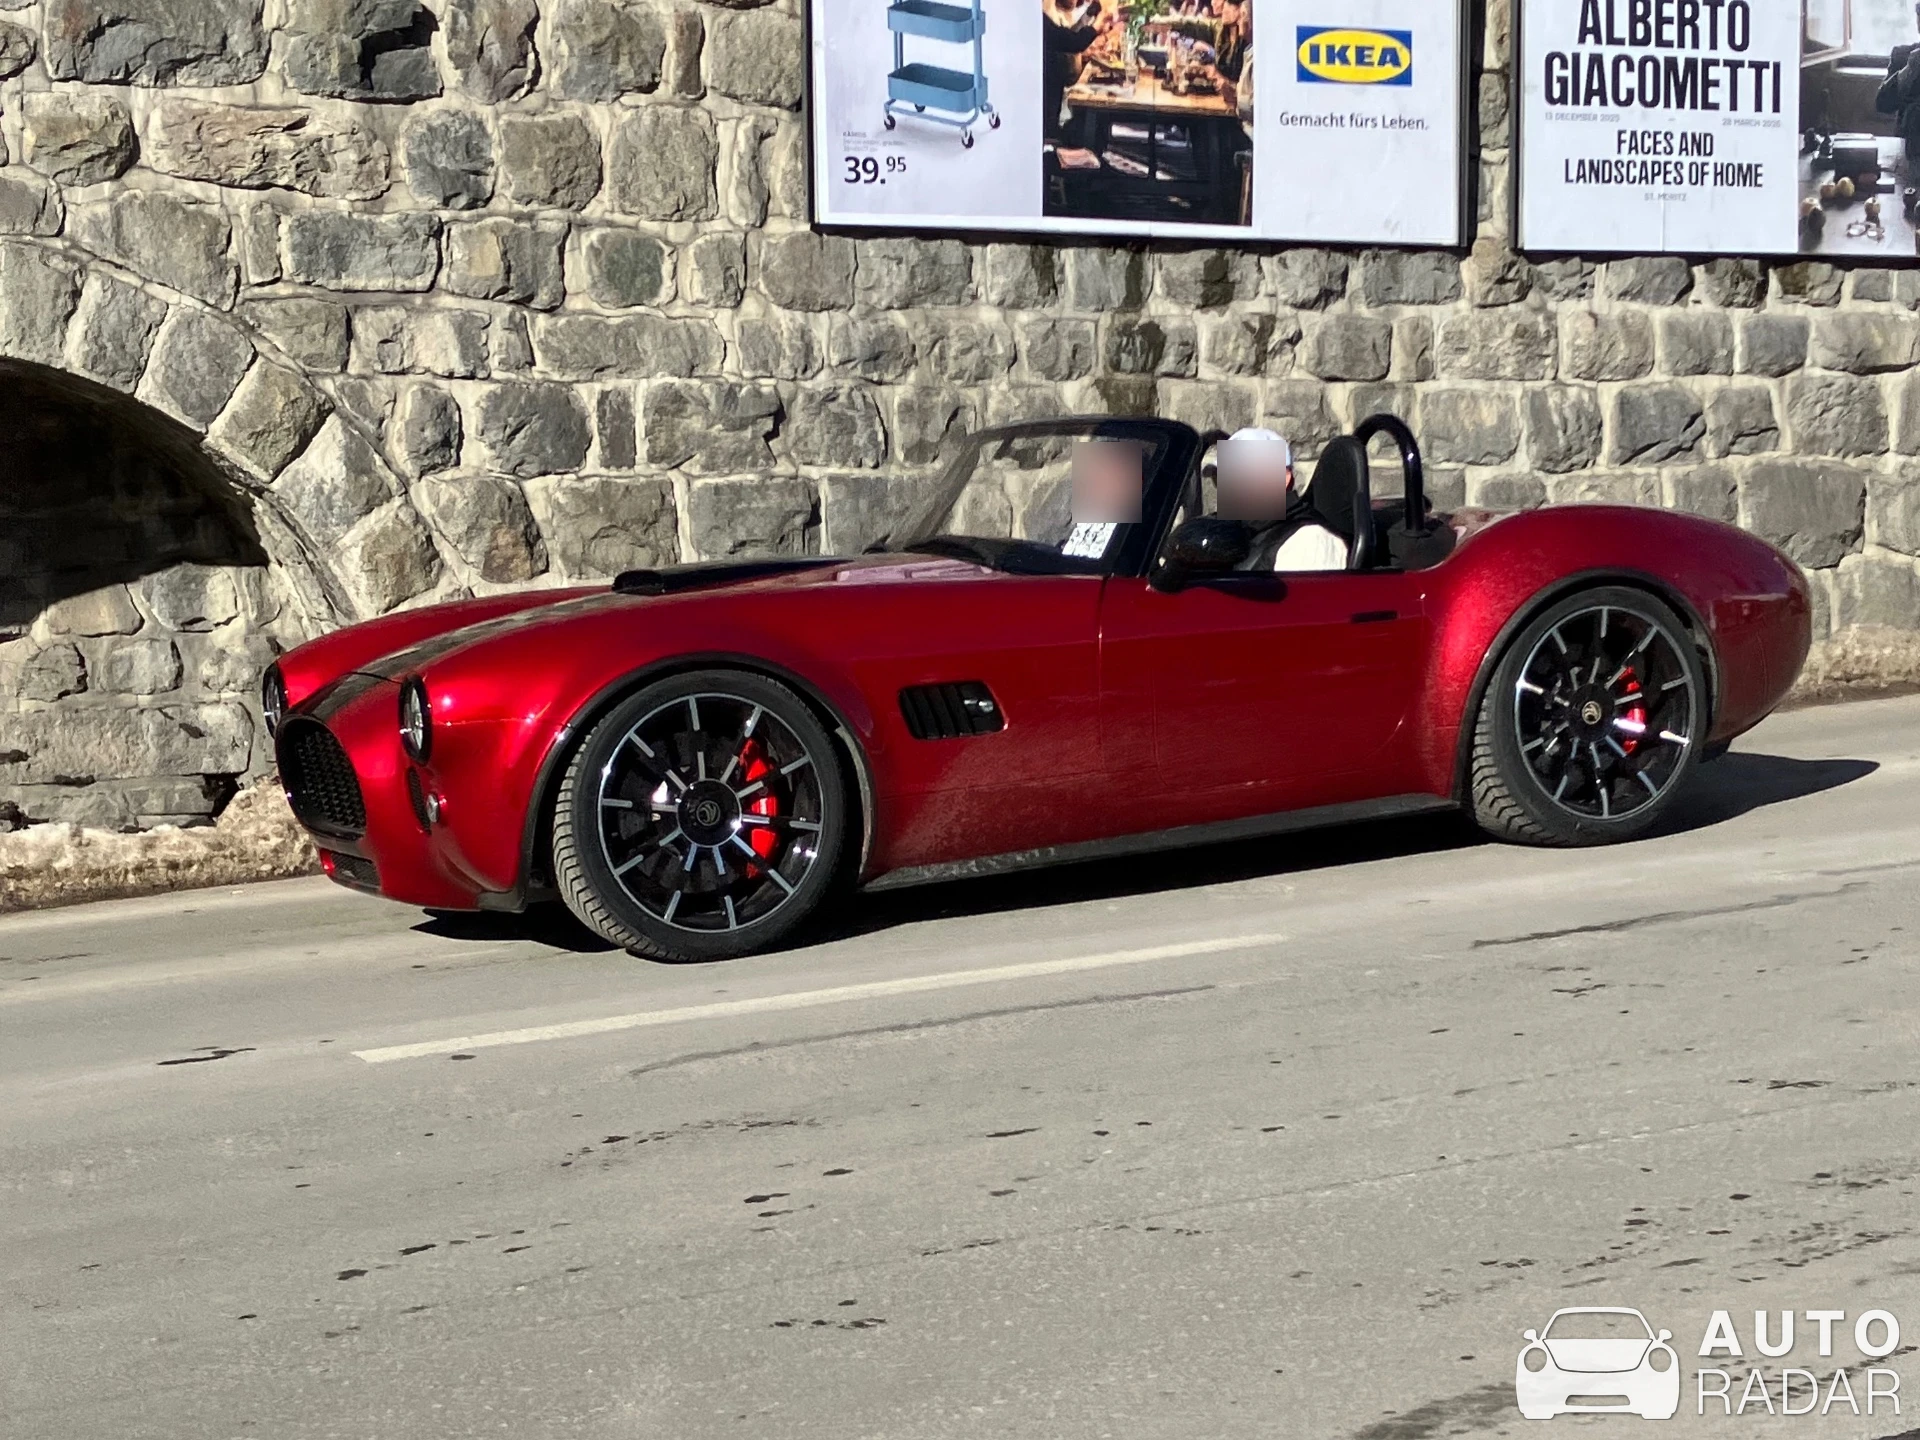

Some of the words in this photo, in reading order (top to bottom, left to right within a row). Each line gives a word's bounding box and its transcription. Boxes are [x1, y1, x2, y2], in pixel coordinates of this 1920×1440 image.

[1578, 0, 1750, 51] ALBERTO
[1309, 43, 1402, 67] IKEA
[1544, 51, 1781, 113] GIACOMETTI
[1280, 112, 1345, 128] Gemacht
[1350, 113, 1378, 128] fürs
[1382, 114, 1430, 131] Leben.
[1617, 130, 1674, 155] FACES
[1678, 132, 1714, 157] AND
[844, 156, 907, 184] 39.95
[1565, 159, 1684, 185] LANDSCAPES
[1688, 162, 1709, 186] OF
[1713, 162, 1763, 187] HOME
